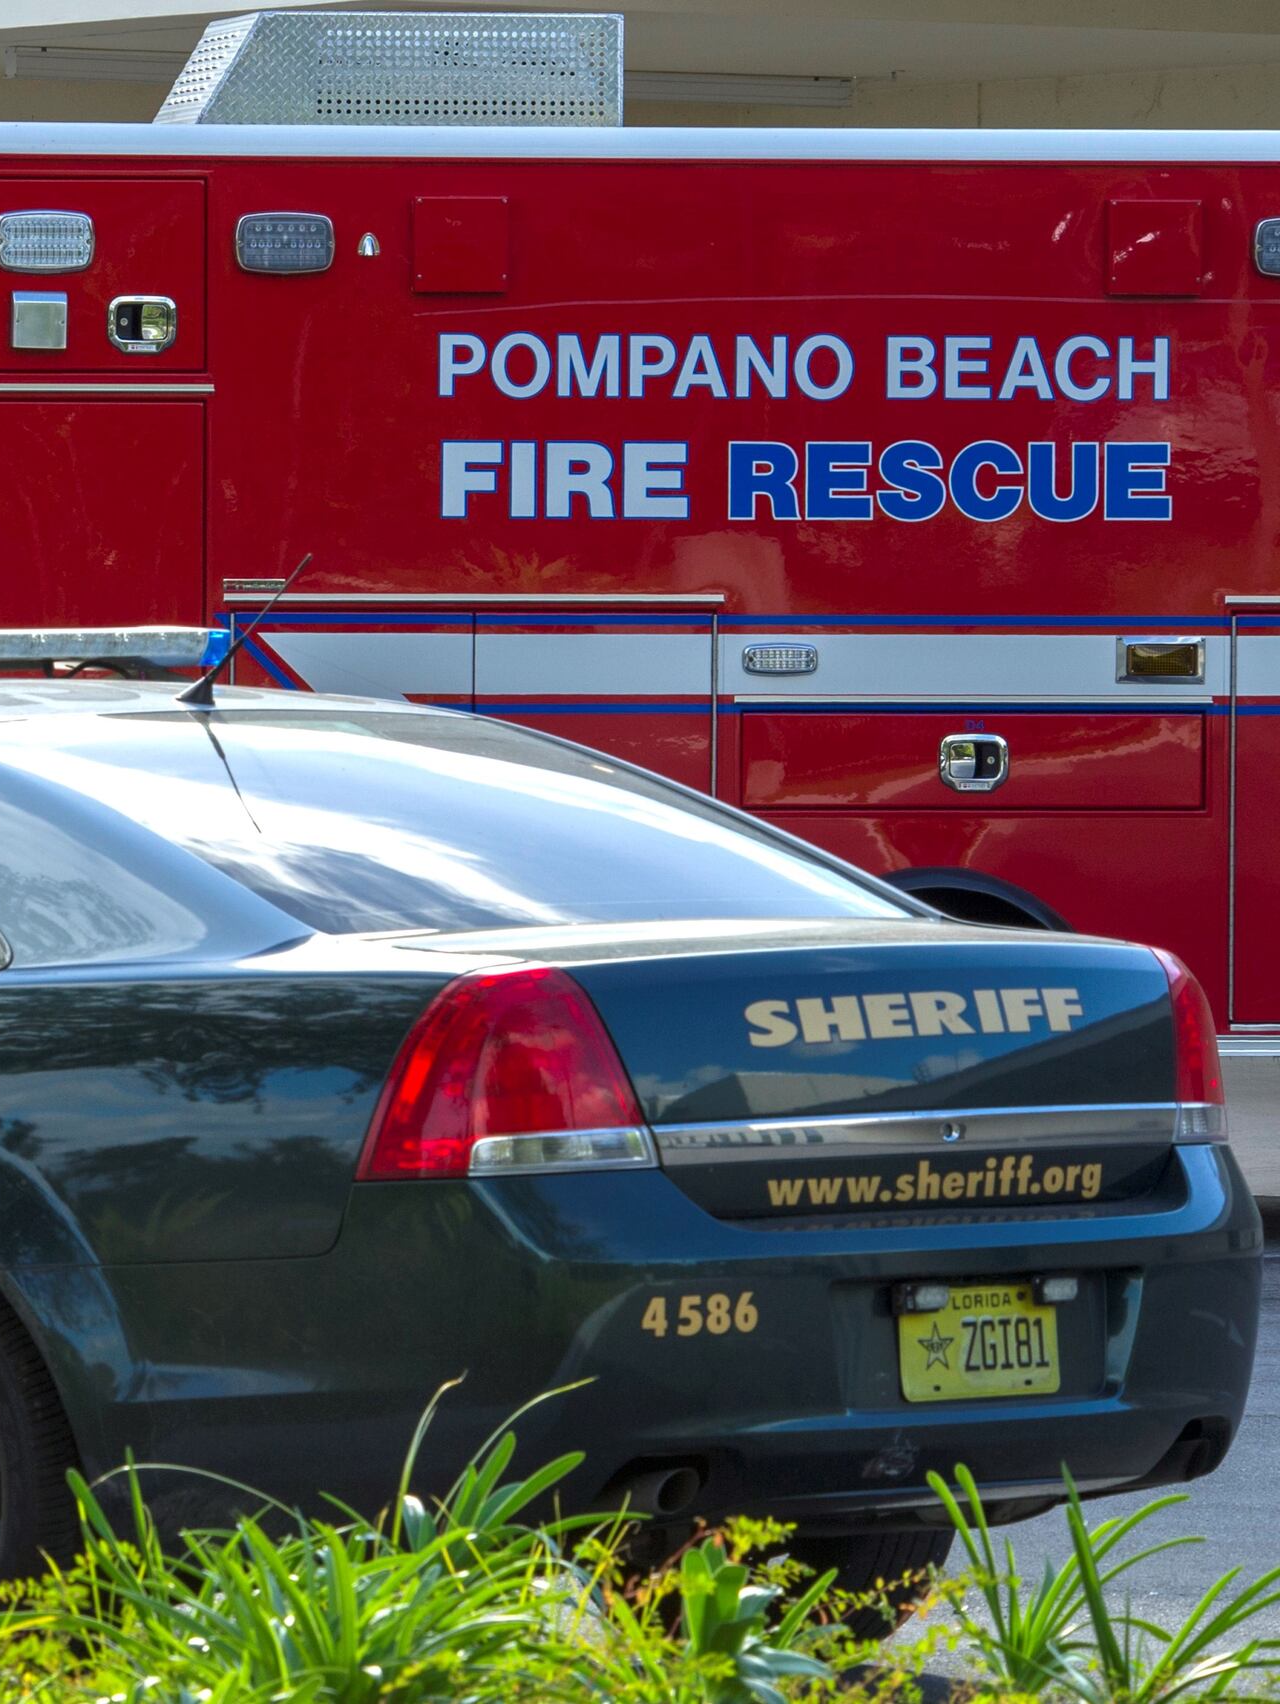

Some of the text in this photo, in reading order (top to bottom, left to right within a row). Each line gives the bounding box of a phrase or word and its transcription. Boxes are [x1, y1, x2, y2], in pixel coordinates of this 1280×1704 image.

[437, 331, 1171, 402] POMPANO BEACH
[440, 439, 1173, 522] FIRE RESCUE
[744, 988, 1083, 1047] SHERIFF
[768, 1155, 1103, 1206] www.sheriff.org
[641, 1291, 759, 1337] 4586
[950, 1293, 1011, 1311] LORIDA
[962, 1318, 1050, 1372] ZGI81
